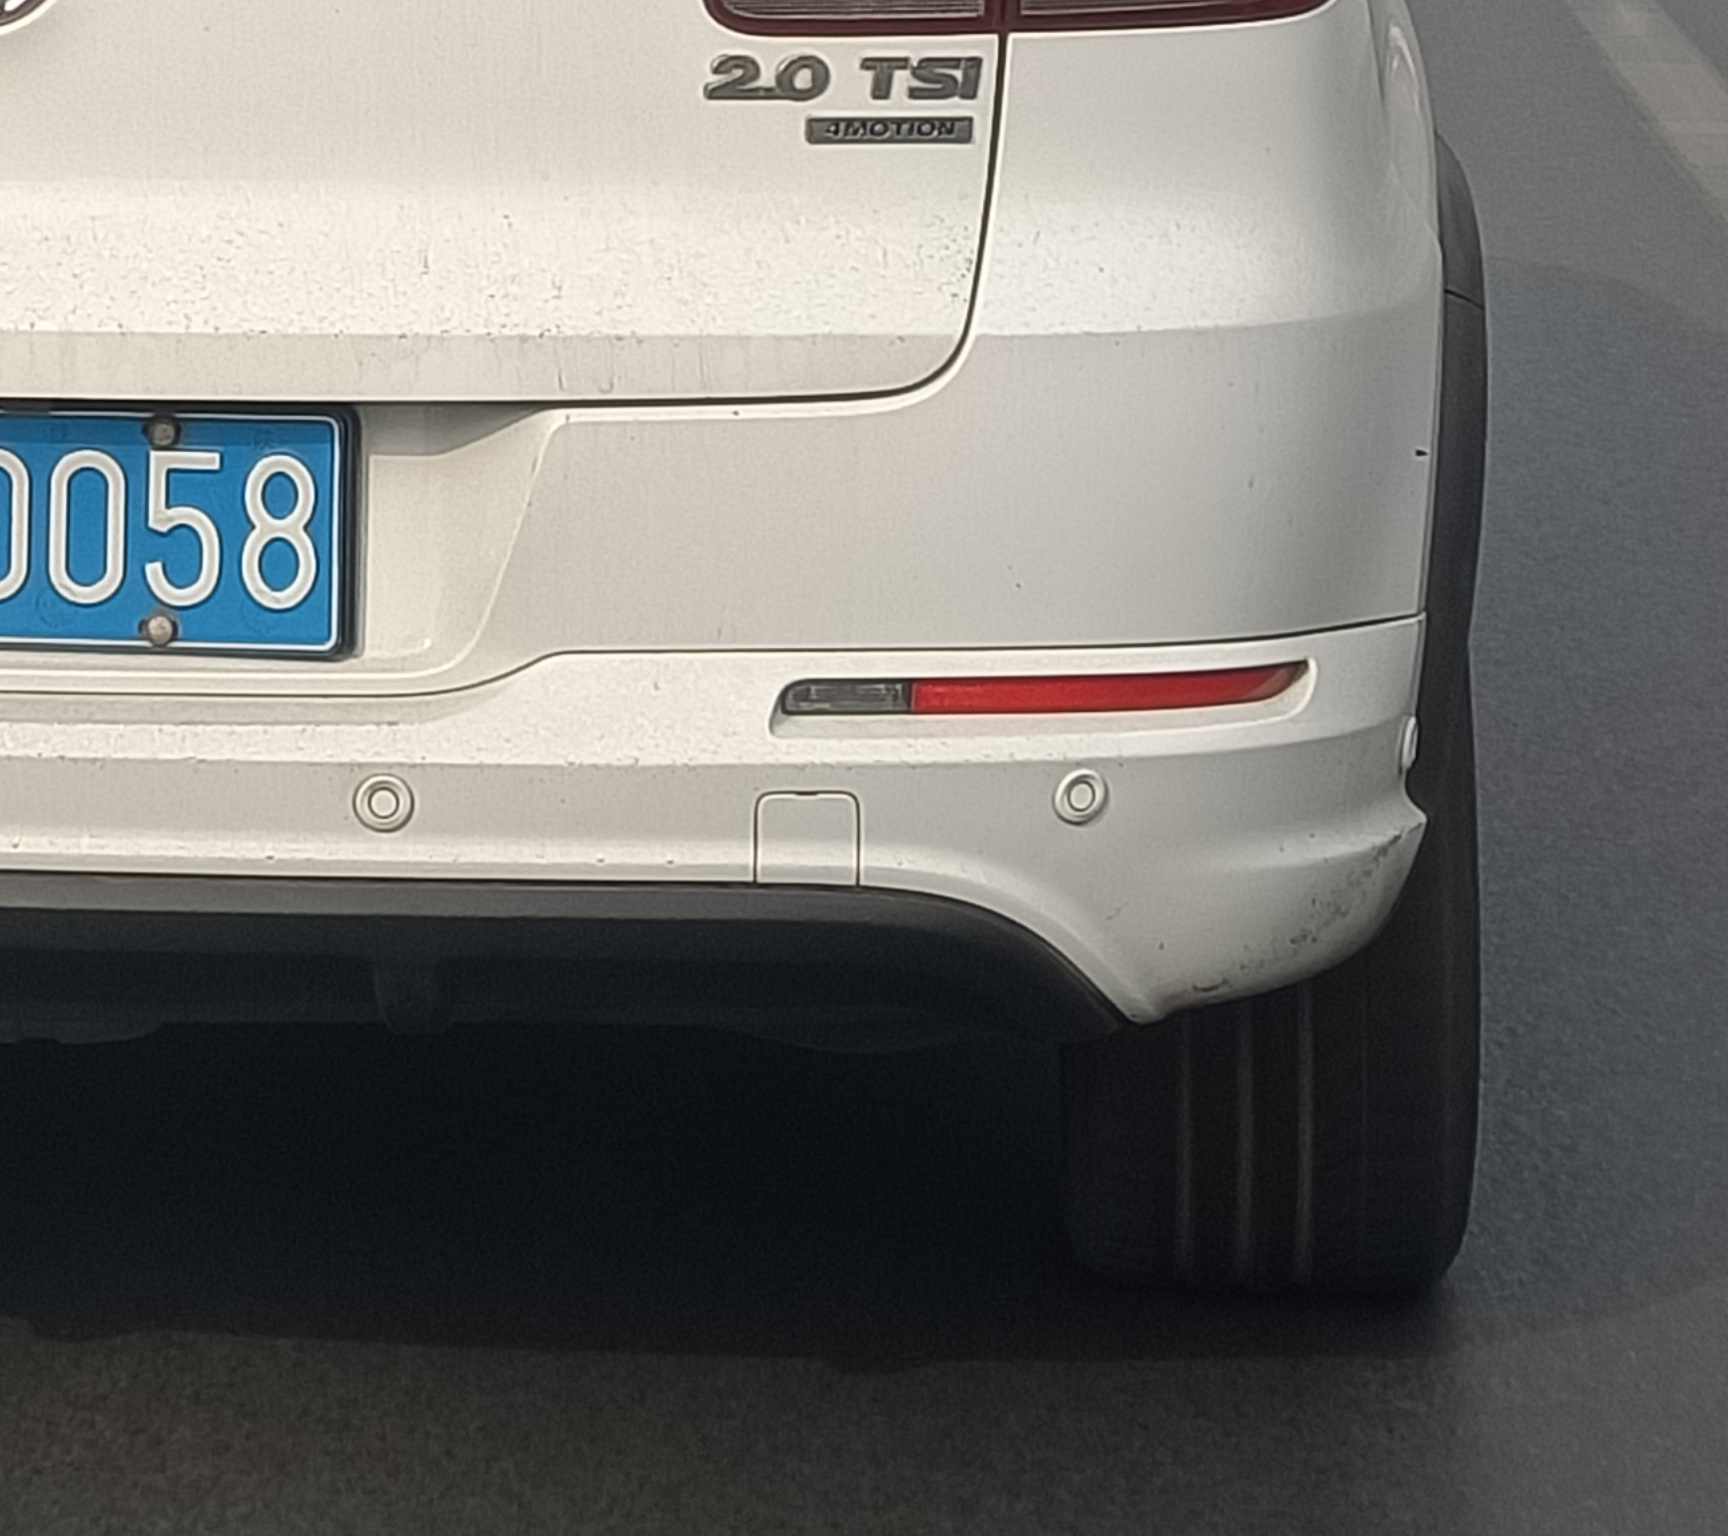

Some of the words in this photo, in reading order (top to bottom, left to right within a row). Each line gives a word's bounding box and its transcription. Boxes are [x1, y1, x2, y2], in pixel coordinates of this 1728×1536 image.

[702, 53, 832, 102] 2.0
[859, 55, 984, 101] TSI
[823, 120, 956, 139] 4MOTION
